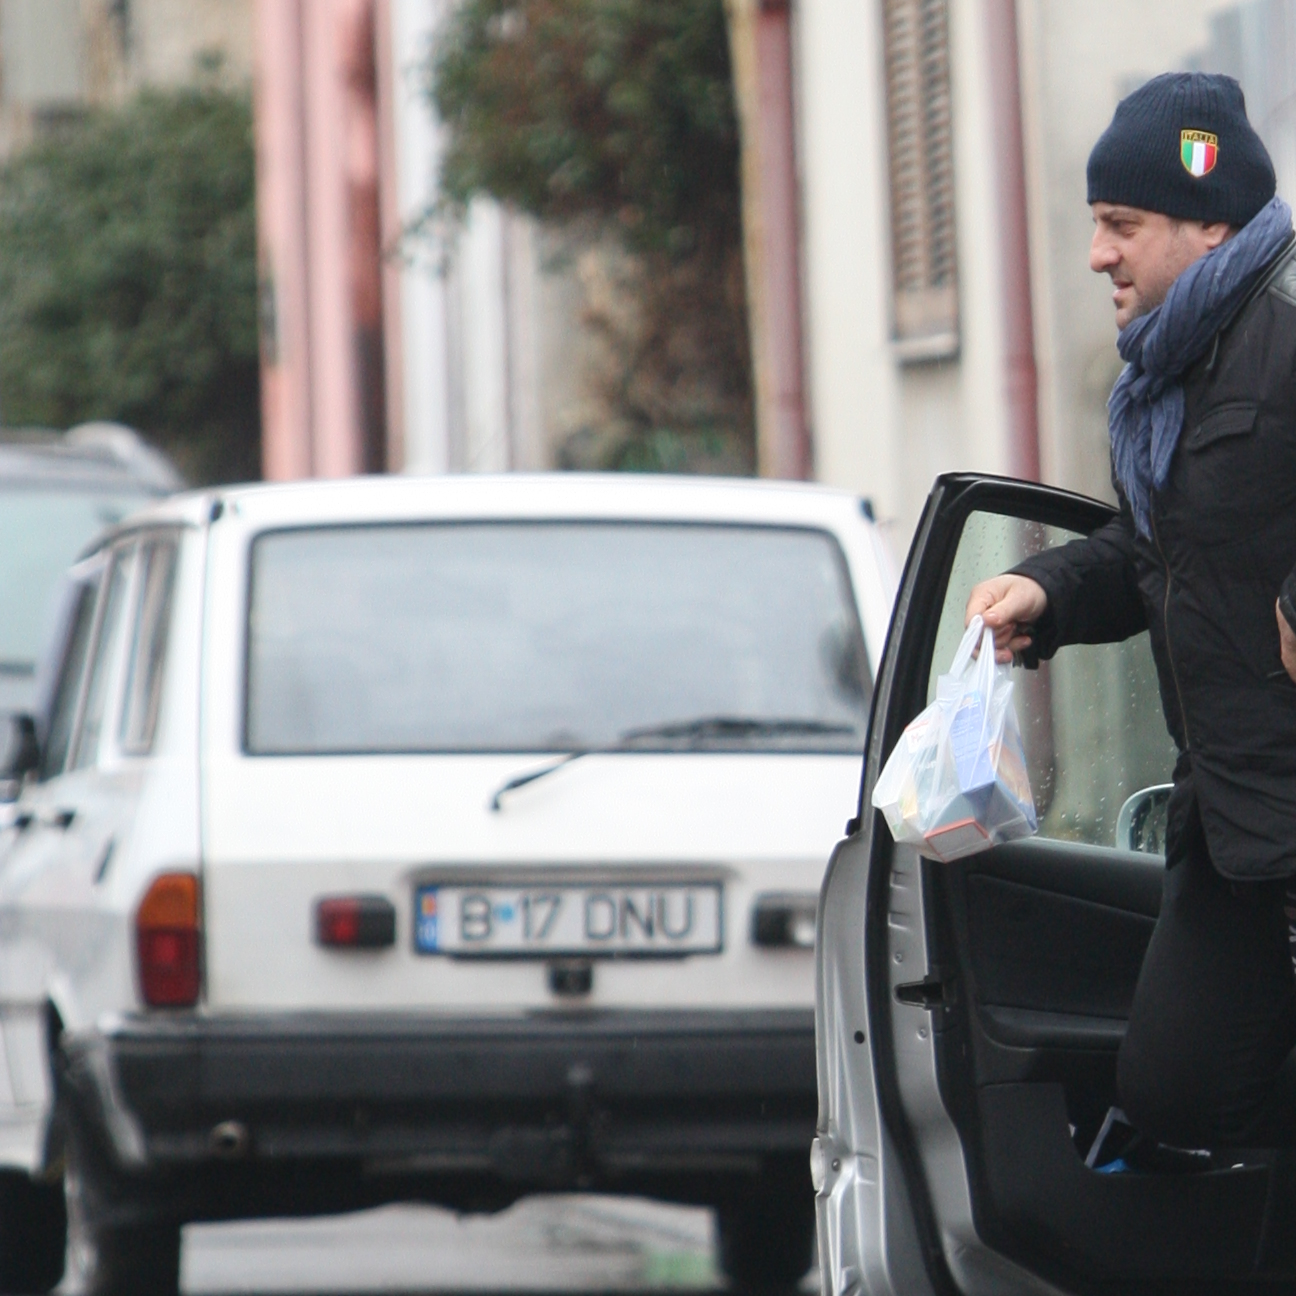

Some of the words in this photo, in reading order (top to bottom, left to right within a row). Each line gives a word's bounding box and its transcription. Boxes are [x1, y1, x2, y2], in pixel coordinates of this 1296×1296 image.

[1182, 132, 1217, 145] ITALIA
[459, 893, 493, 941] B
[520, 893, 563, 940] 17
[584, 892, 695, 940] DNU
